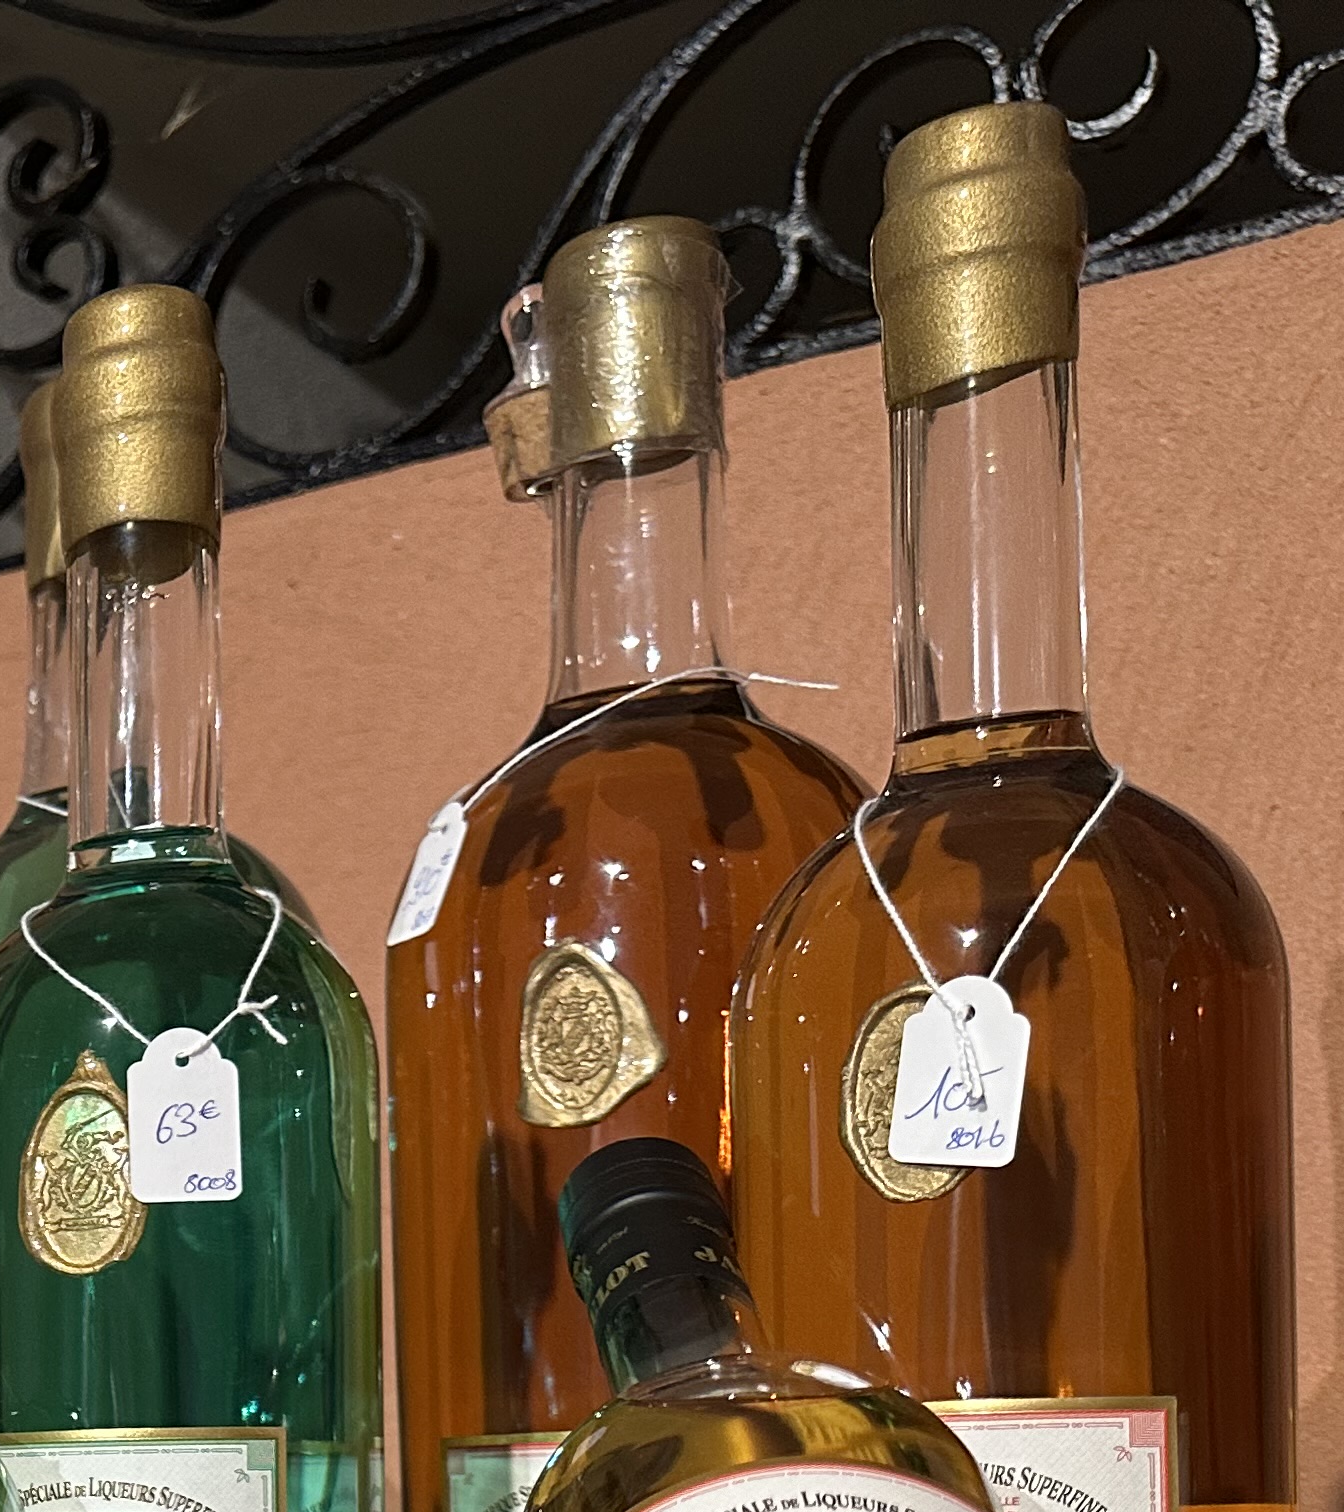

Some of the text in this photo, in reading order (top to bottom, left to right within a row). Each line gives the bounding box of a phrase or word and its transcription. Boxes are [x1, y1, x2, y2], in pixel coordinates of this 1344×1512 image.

[155, 1099, 222, 1144] 63€
[74, 1486, 87, 1498] DE
[88, 1476, 158, 1504] LIQUEURS
[781, 1498, 800, 1509] DE
